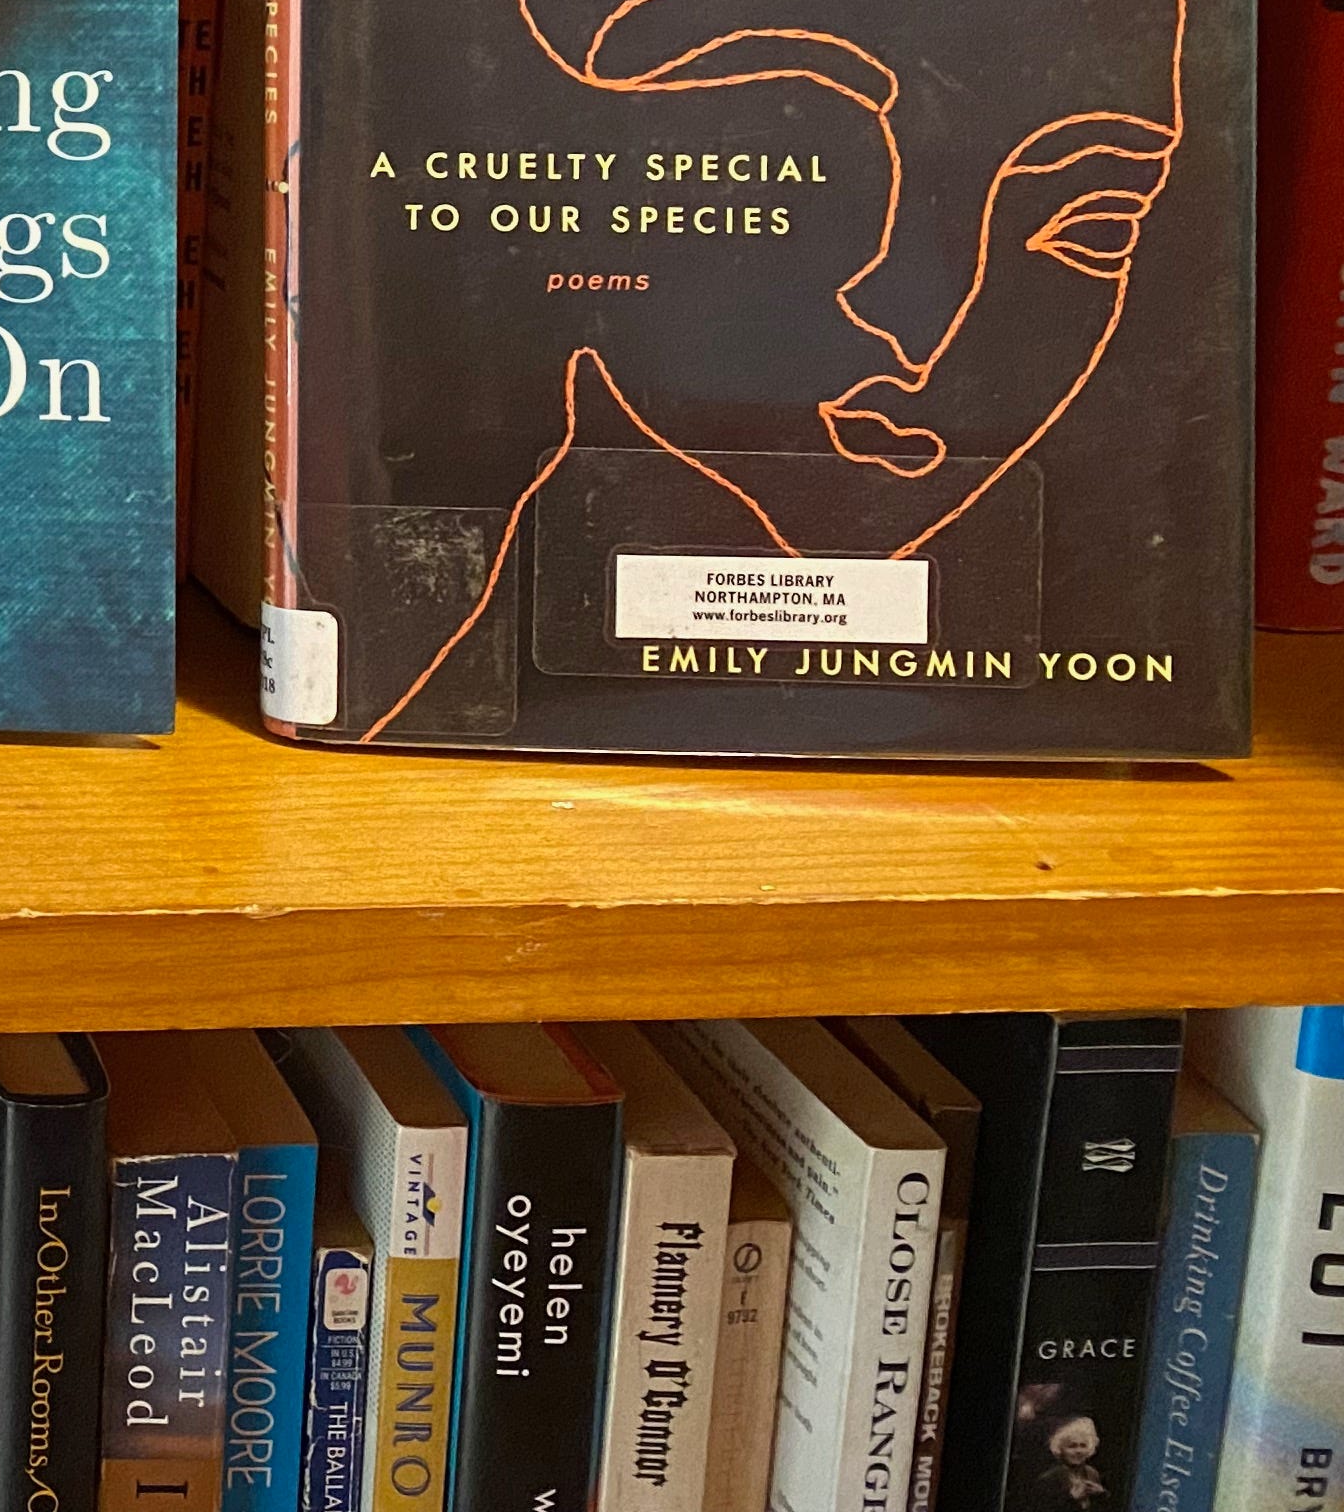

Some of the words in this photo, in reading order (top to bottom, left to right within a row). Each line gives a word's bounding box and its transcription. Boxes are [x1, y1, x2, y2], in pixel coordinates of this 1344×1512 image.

[369, 152, 396, 179] A
[426, 152, 620, 182] CRUELTY
[645, 154, 827, 183] SPECIAL
[405, 203, 460, 232] TO
[490, 204, 582, 233] OUR
[610, 205, 791, 235] SPECIES
[546, 270, 650, 294] poems
[692, 608, 847, 625] www.forbeslibrary.org
[694, 591, 818, 607] NORTHAMPTON,
[823, 592, 846, 606] MA
[705, 573, 765, 587] FORBES
[770, 573, 834, 587] LIBRARY
[641, 645, 767, 674] EMILY
[794, 647, 1012, 678] JUNGMIN
[1039, 650, 1174, 682] YOON
[237, 1174, 288, 1314] LORRIE
[404, 1154, 422, 1256] VINTAGE
[882, 1171, 932, 1337] CLOSE
[1173, 1164, 1229, 1314] Drinking
[127, 1176, 178, 1426] MacLeod
[178, 1196, 229, 1407] Alistair
[491, 1194, 532, 1377] oyeyemi
[544, 1228, 587, 1345] helen
[637, 1221, 705, 1347] Flannery
[390, 1293, 440, 1497] MUNRO
[1038, 1338, 1136, 1360] GRACE
[1166, 1328, 1209, 1426] Coffee
[226, 1332, 278, 1489] MOORE
[328, 1401, 348, 1441] THE
